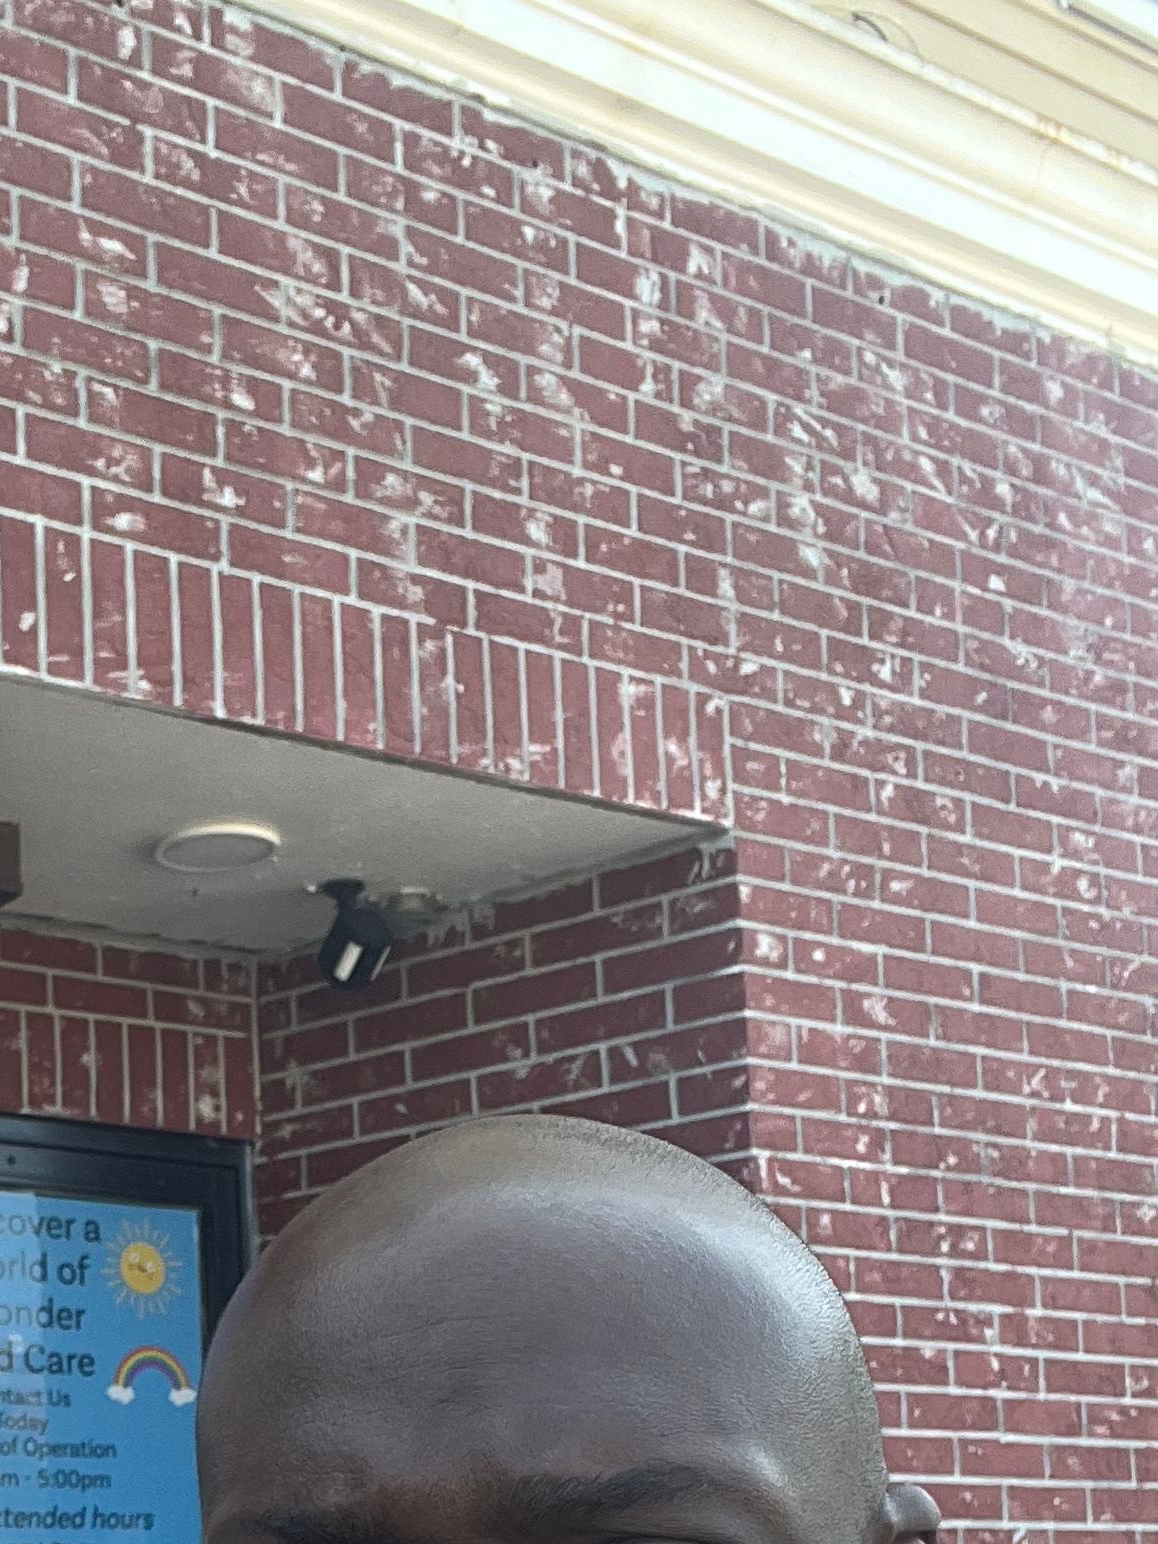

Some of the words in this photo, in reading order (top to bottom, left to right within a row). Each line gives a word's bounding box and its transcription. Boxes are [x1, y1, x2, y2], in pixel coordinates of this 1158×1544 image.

[84, 1219, 102, 1243] a
[57, 1254, 90, 1287] of
[24, 1344, 96, 1377] Care
[46, 1389, 72, 1407] Us
[0, 1437, 18, 1456] of
[24, 1437, 117, 1460] Operation
[91, 1505, 156, 1530] hours
